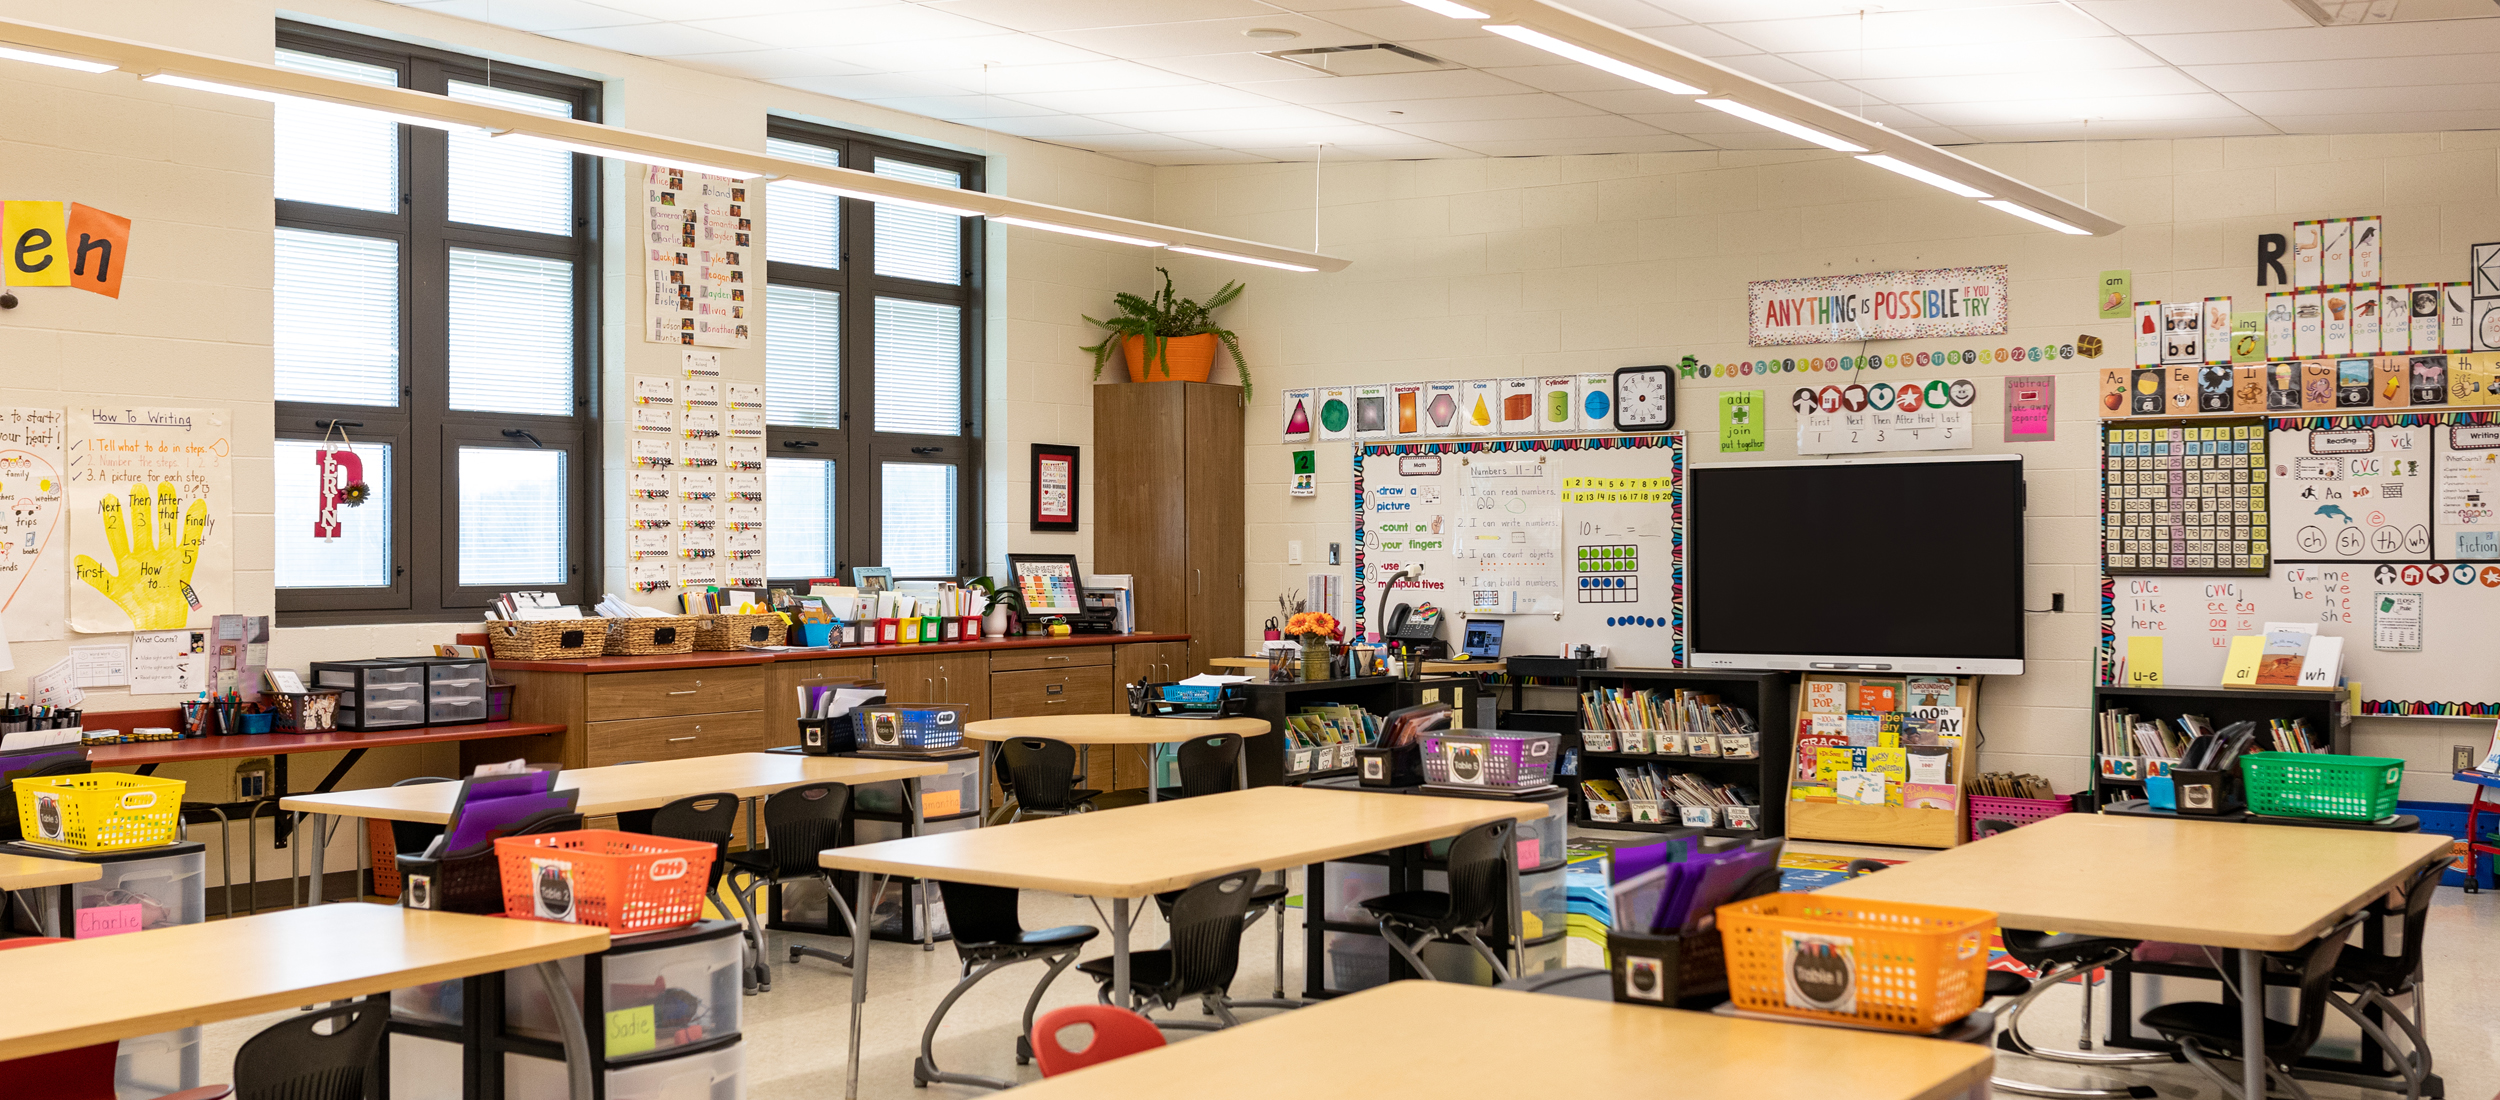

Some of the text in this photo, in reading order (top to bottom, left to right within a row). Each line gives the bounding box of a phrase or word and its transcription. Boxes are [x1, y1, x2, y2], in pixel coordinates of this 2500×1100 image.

[2257, 234, 2287, 286] R
[2302, 254, 2313, 263] ar
[2332, 252, 2342, 260] or
[2361, 251, 2371, 259] er
[2364, 259, 2369, 268] ir
[2106, 278, 2123, 286] am
[1766, 285, 1989, 328] ANYTHING IS POSSIBLE IF YOU
[1963, 297, 1990, 316] TRY
[2240, 320, 2256, 331] ing
[2308, 362, 2330, 376] Oo
[2383, 359, 2400, 373] Uu
[2458, 357, 2472, 370] th
[2107, 371, 2123, 384] Aa
[2174, 369, 2189, 382] Ee
[1727, 394, 1750, 405] add
[2008, 402, 2027, 412] take
[11, 409, 21, 423] to
[92, 409, 192, 431] How To Writing
[1810, 413, 1960, 426] First Next Then After that Last
[2011, 413, 2048, 424] separate
[1727, 426, 1750, 437] join
[2470, 432, 2499, 440] Writing
[96, 439, 115, 451] Tell
[118, 439, 139, 452] what
[144, 440, 153, 452] to
[158, 440, 168, 452] do
[172, 443, 180, 452] in
[1721, 438, 1764, 450] put together
[2326, 437, 2357, 445] Reading
[1301, 456, 1309, 469] 2
[2186, 458, 2196, 466] 26
[2202, 458, 2213, 466] 27
[2235, 457, 2246, 465] 29
[2252, 457, 2264, 465] 30
[5, 470, 29, 481] family
[87, 468, 96, 481] 3.
[99, 469, 106, 481] A
[112, 471, 142, 484] picture
[147, 470, 160, 482] for
[164, 471, 182, 482] each
[1471, 466, 1507, 475] Numbers
[158, 493, 183, 505] After
[321, 442, 338, 543] PERINI
[2326, 488, 2342, 499] Aa
[98, 498, 121, 514] Next
[128, 494, 152, 507] Then
[1377, 501, 1410, 512] picture
[159, 507, 179, 520] that
[16, 517, 37, 528] trips
[186, 514, 215, 535] Finally
[183, 534, 206, 546] Last
[1381, 539, 1442, 550] your fingers
[2304, 529, 2425, 550] ch sh th wh
[2459, 536, 2498, 553] fiction
[76, 562, 104, 580] First
[140, 562, 162, 576] How
[2294, 587, 2313, 600] be
[2135, 599, 2166, 613] like
[2131, 616, 2167, 631] here
[135, 635, 178, 643] What Counts?
[2133, 670, 2158, 682] u-e
[2236, 666, 2251, 679] ai
[2305, 668, 2326, 681] wh
[1812, 684, 1833, 693] HOP
[1812, 698, 1833, 707] POP
[1454, 761, 1472, 770] Table
[2102, 760, 2136, 776] ABC
[541, 886, 570, 899] Table 2
[81, 911, 139, 932] Charlie
[1798, 966, 1834, 985] Table
[611, 1014, 650, 1040] Sadie
